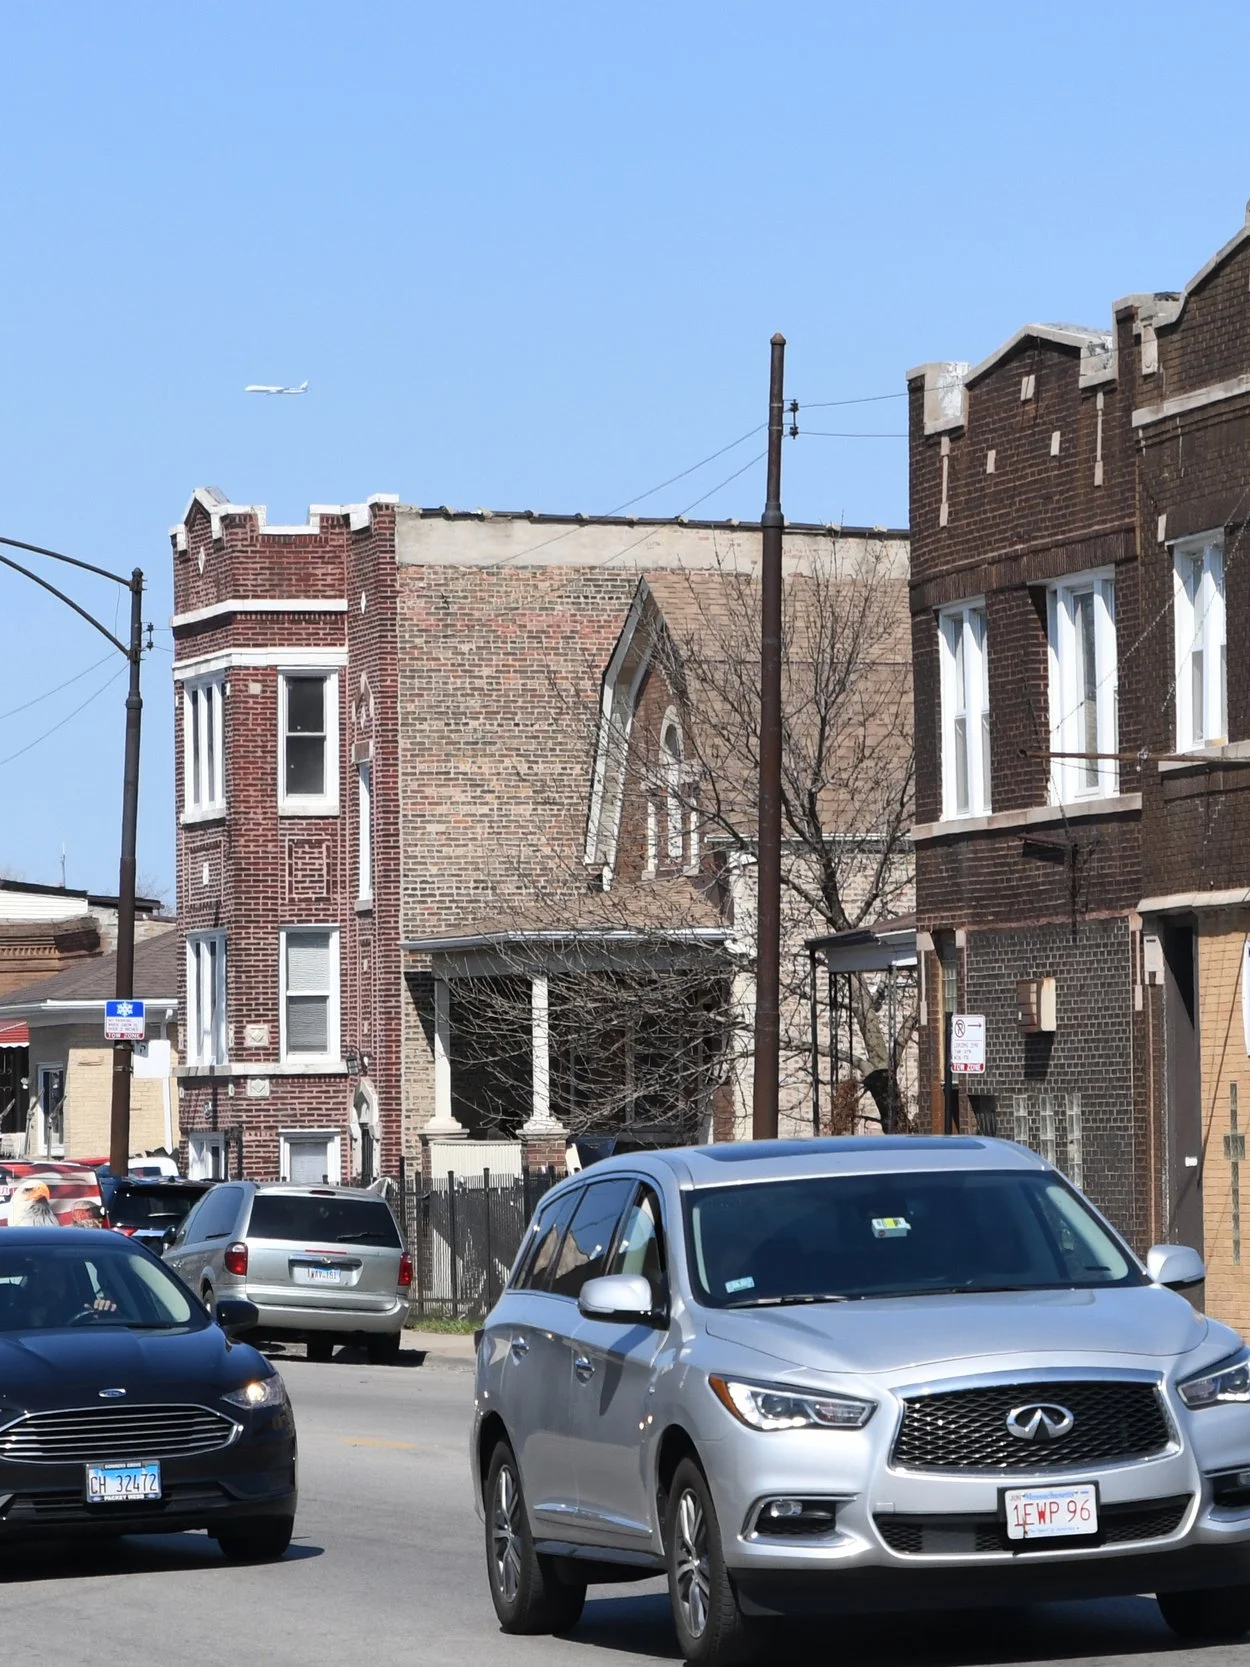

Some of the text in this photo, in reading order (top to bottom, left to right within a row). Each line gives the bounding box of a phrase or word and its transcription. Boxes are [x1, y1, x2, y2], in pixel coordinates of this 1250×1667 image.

[90, 1474, 157, 1494] CH 32472
[1013, 1499, 1091, 1527] 1EWP 96
